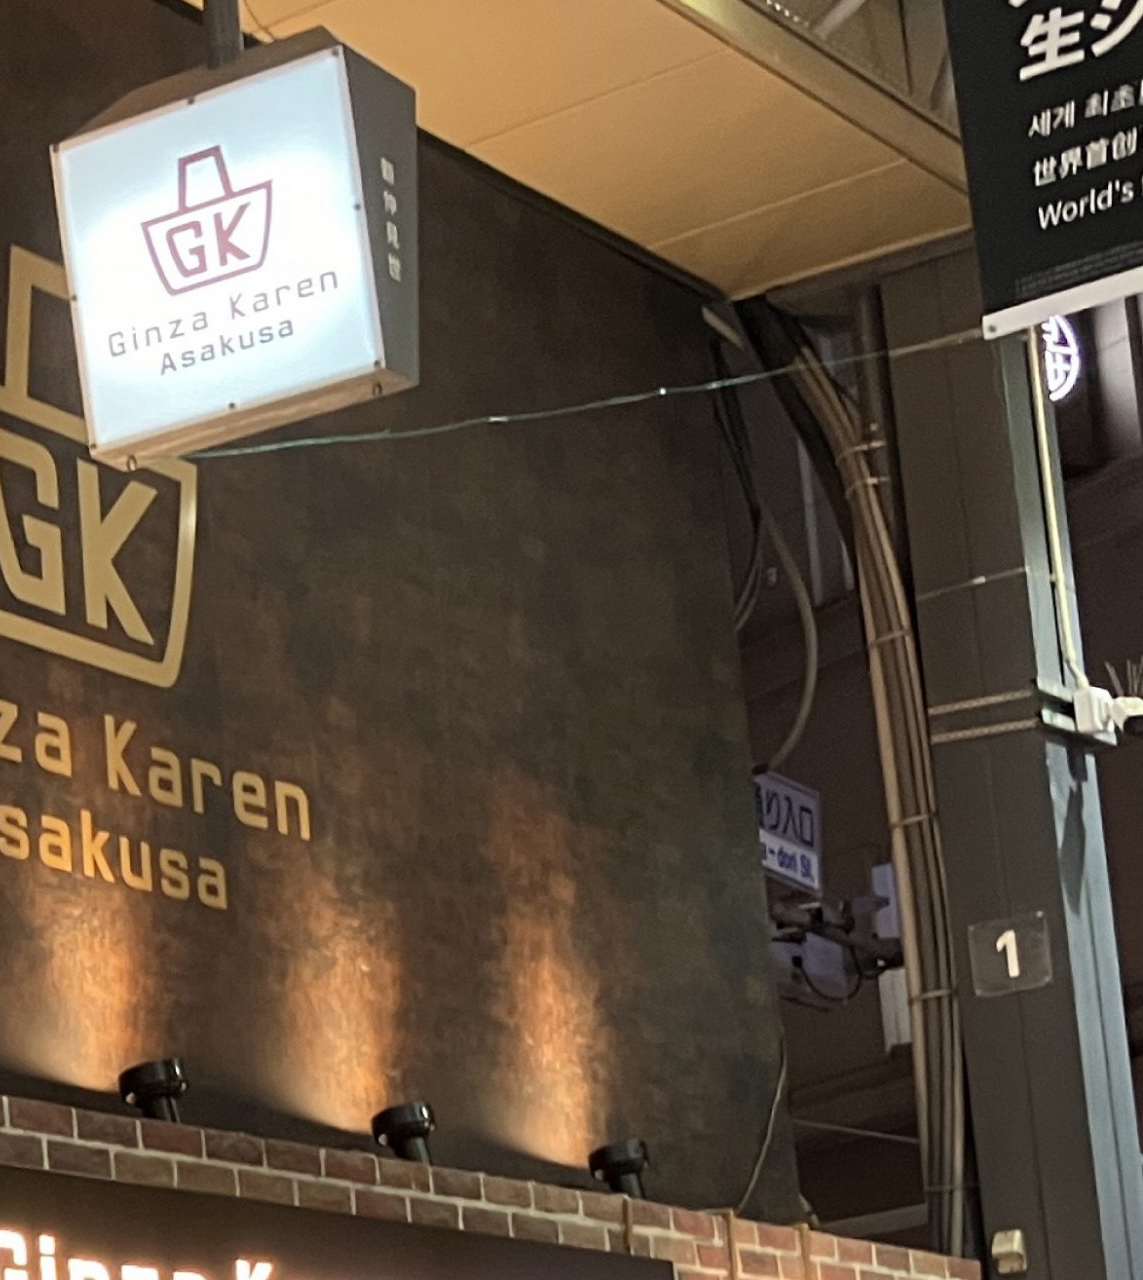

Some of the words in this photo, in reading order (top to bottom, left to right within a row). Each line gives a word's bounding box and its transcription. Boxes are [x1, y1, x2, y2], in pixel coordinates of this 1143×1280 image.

[1038, 179, 1134, 229] World's
[165, 201, 251, 278] GK
[107, 312, 209, 357] Ginza
[229, 269, 338, 320] Karen
[160, 319, 294, 375] Asakusa
[104, 714, 310, 841] Karen
[756, 784, 813, 848] り入口
[996, 929, 1020, 978] 1
